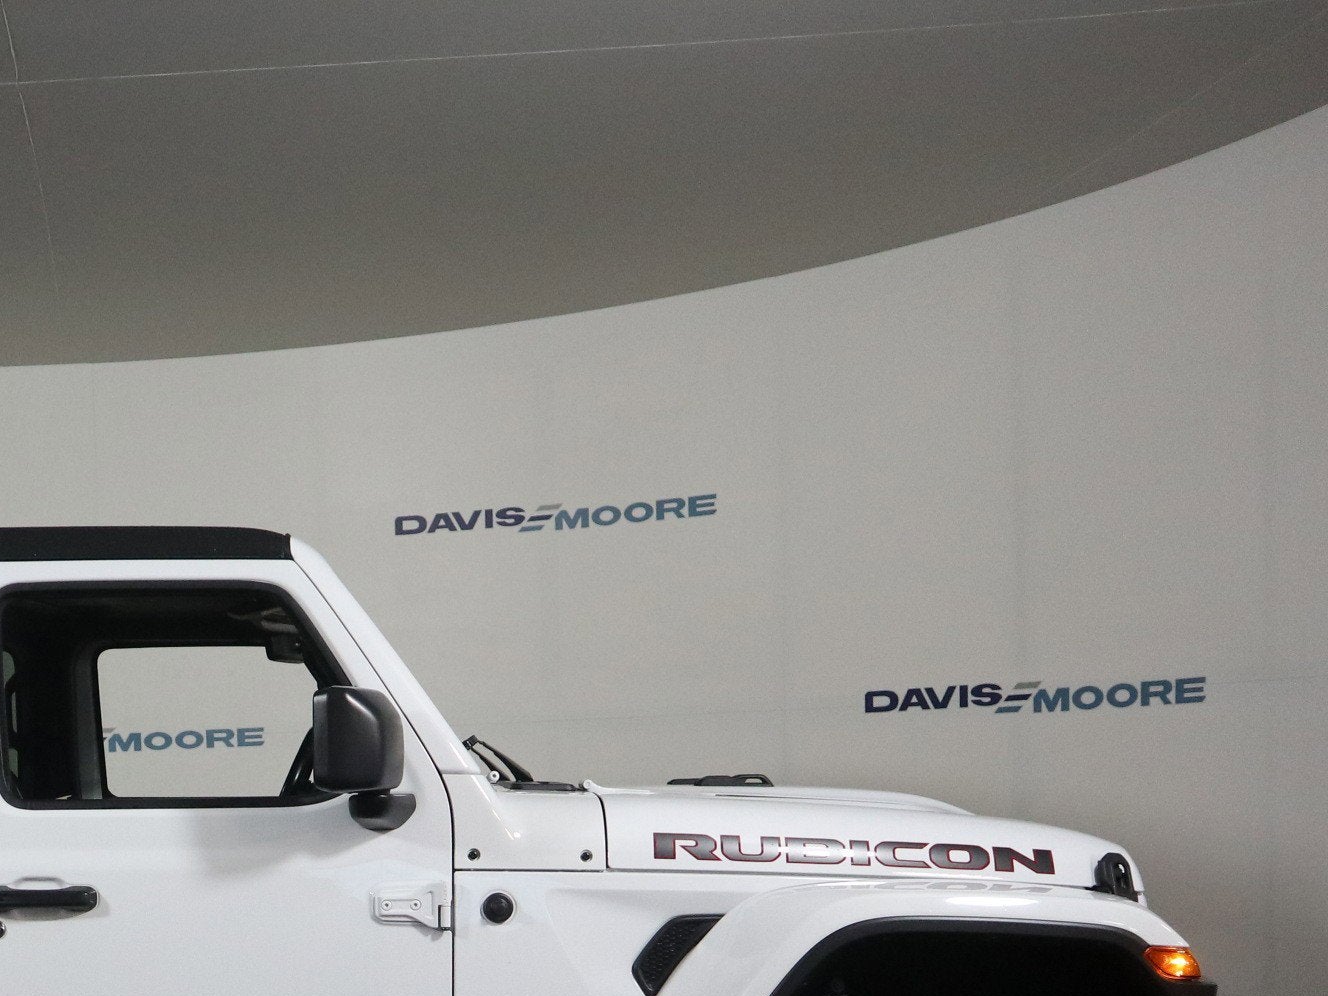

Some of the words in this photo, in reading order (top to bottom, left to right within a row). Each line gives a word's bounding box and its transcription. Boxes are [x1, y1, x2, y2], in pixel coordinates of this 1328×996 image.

[394, 507, 526, 536] DAVIS
[554, 493, 717, 530] MOORE
[864, 683, 1003, 714] DAVIS
[1033, 677, 1206, 714] MOORE
[108, 727, 265, 752] MOORE
[653, 832, 1056, 875] RUBICON
